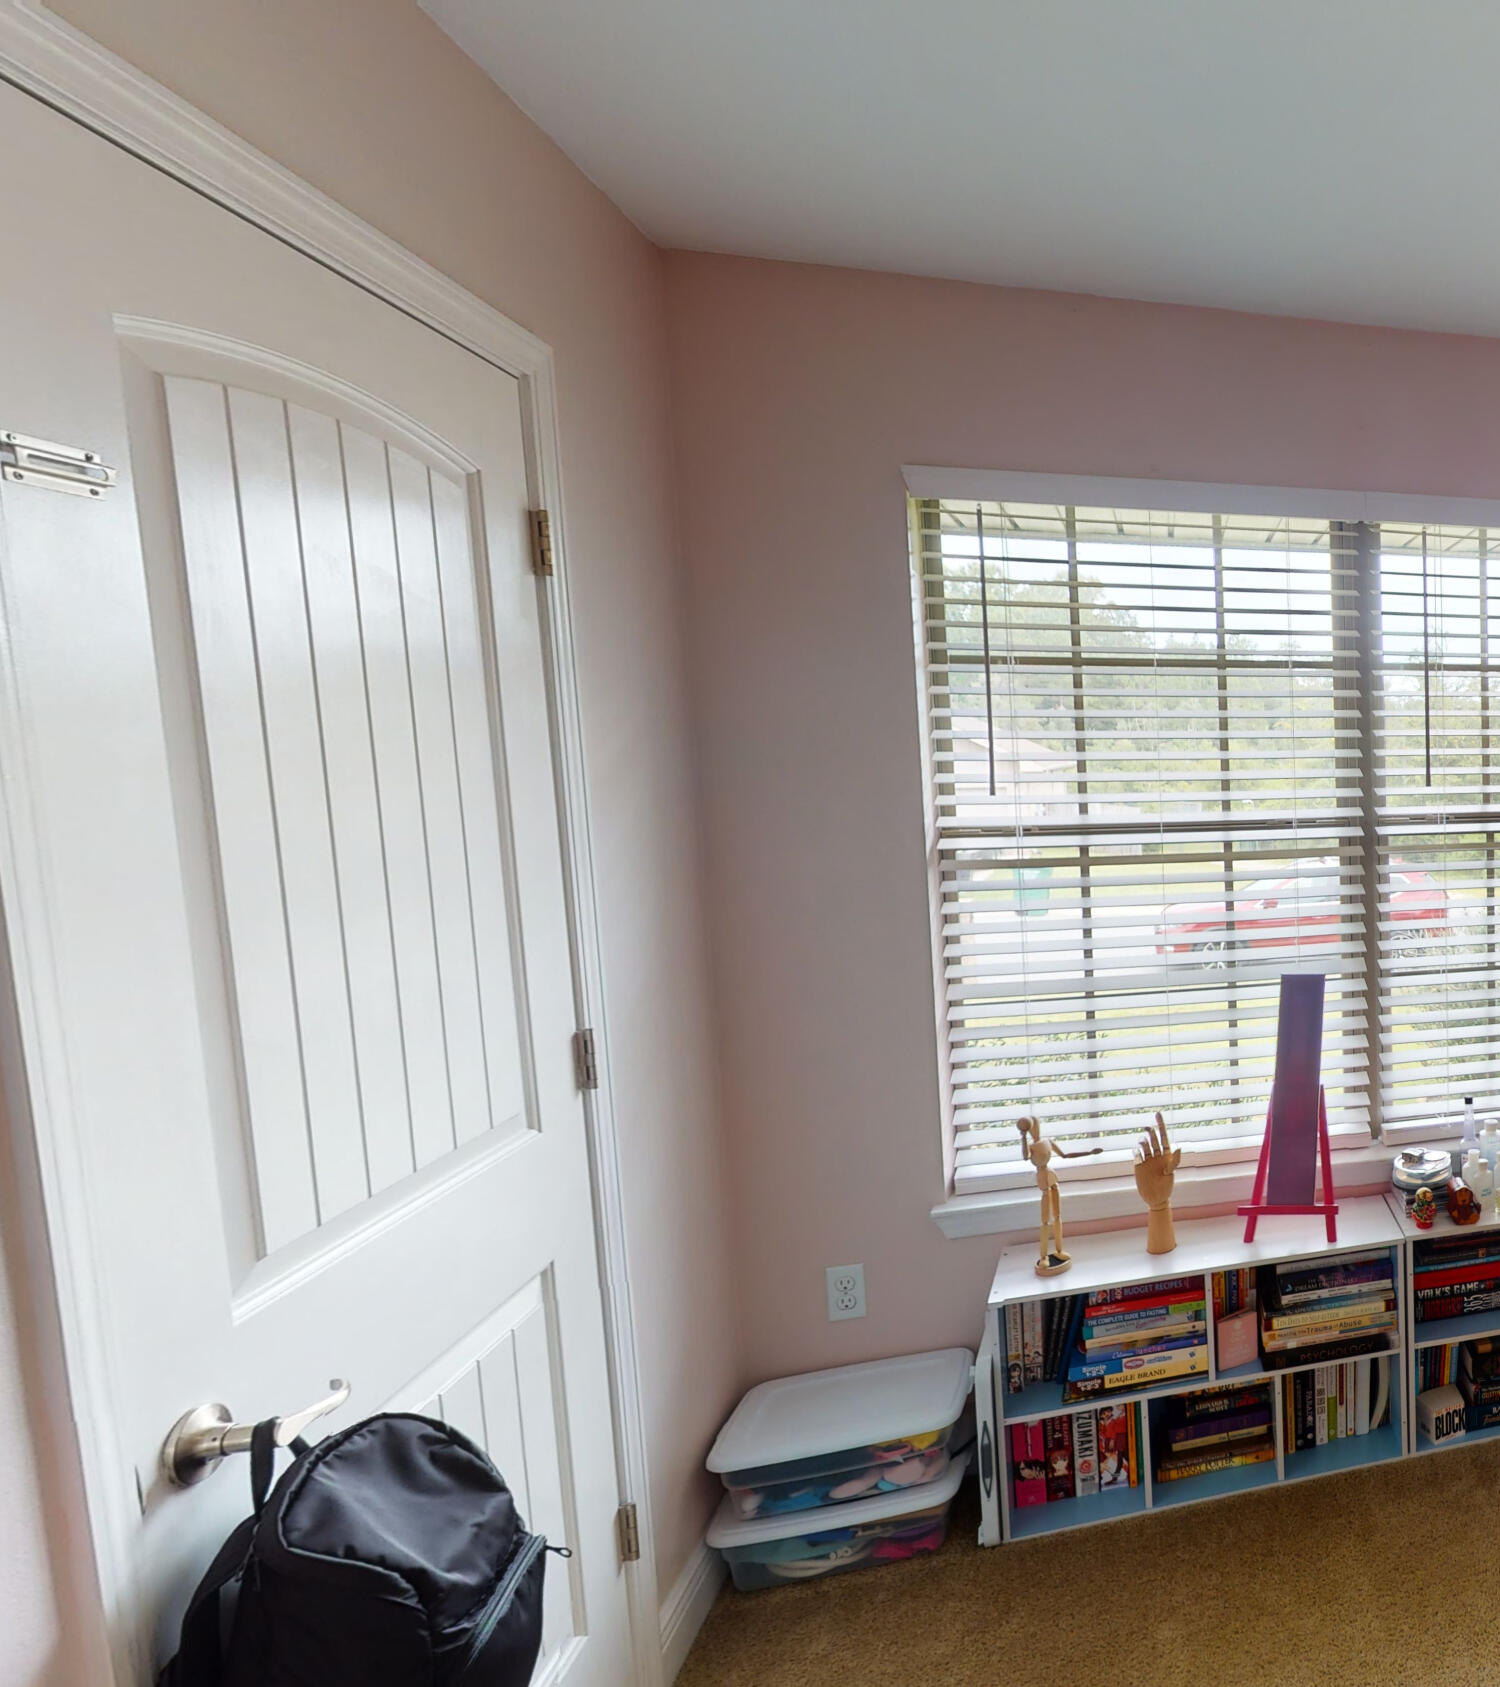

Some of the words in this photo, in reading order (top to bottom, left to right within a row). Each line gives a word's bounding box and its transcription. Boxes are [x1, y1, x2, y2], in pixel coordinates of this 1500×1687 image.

[1123, 1286, 1153, 1296] BUDGET
[1155, 1280, 1183, 1291] RECIPES
[1417, 1286, 1451, 1299] VOLK'S
[1453, 1281, 1479, 1294] GAME
[1087, 1319, 1097, 1327] THE
[1097, 1315, 1123, 1325] COMPLETE
[1124, 1313, 1139, 1321] GUIDE
[1146, 1308, 1167, 1318] FASTING
[1306, 1324, 1333, 1335] Trauma
[1339, 1319, 1362, 1328] Abuse
[1301, 1341, 1375, 1360] PSYCHOLOGY
[1109, 1374, 1135, 1385] EAGLE
[1137, 1368, 1166, 1379] BRAND
[1435, 1408, 1466, 1440] BLOCK
